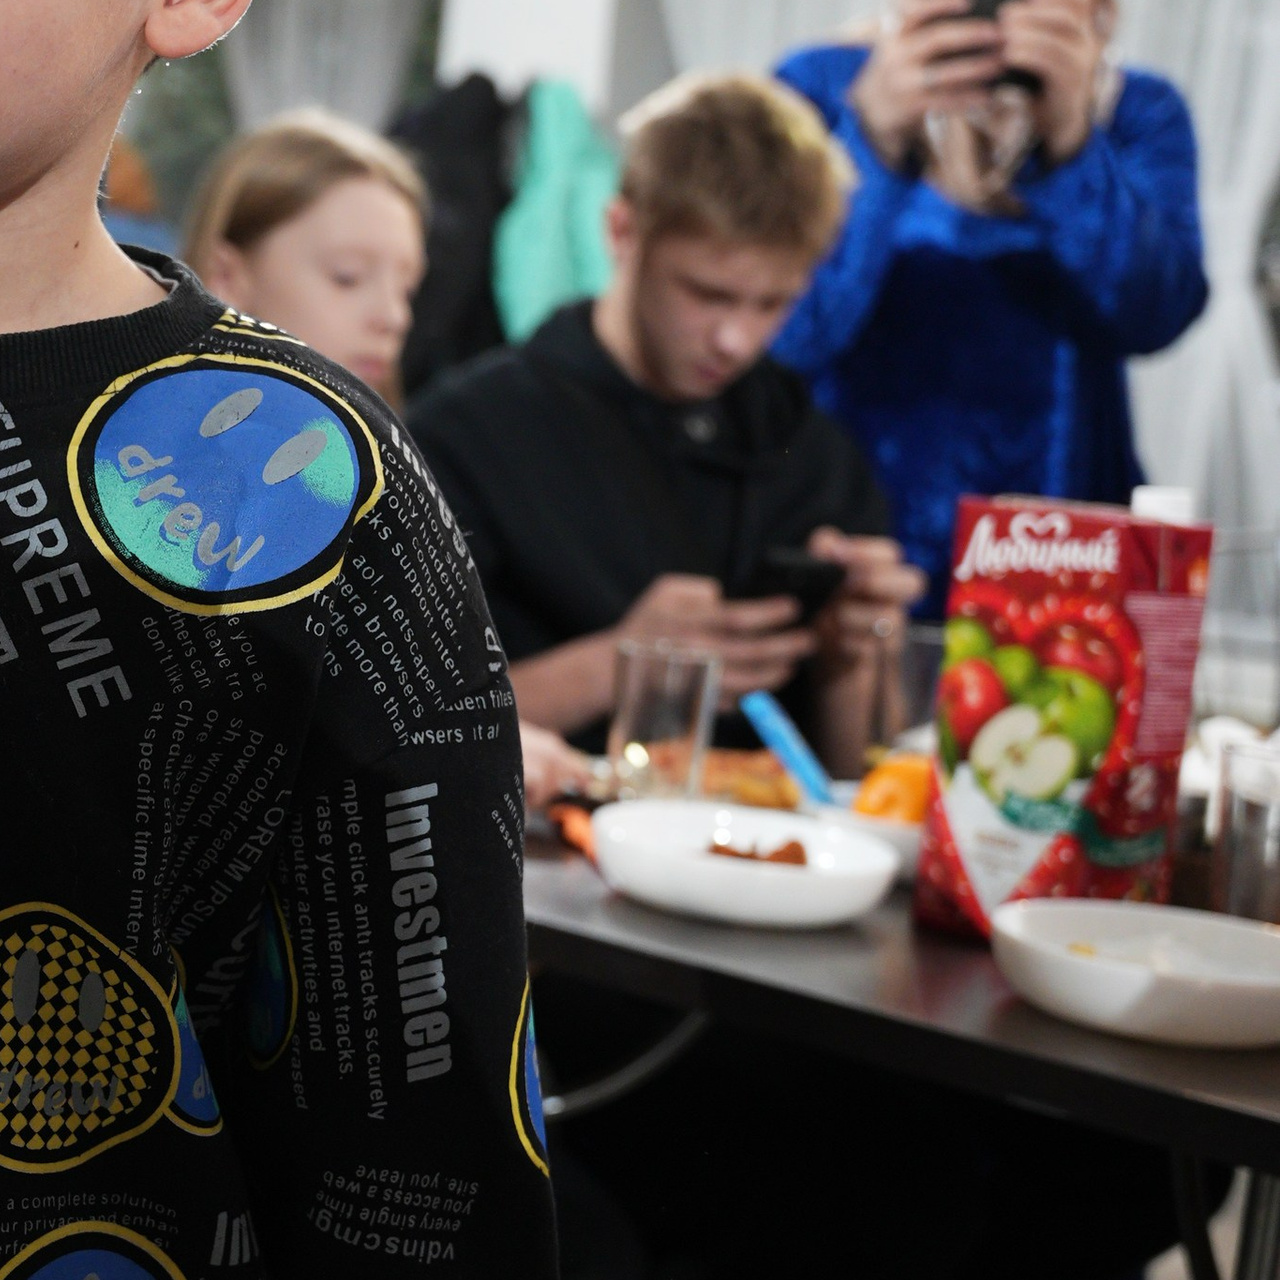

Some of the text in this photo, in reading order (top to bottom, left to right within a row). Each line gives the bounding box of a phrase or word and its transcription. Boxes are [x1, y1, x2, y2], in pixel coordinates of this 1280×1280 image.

[117, 443, 266, 573] drew
[379, 487, 413, 531] your
[352, 554, 385, 594] aol,
[953, 510, 1122, 581] Любимый
[392, 542, 434, 622] support
[165, 663, 185, 695] like
[203, 621, 231, 669] leave
[230, 629, 258, 667] you
[365, 614, 424, 718] browsers
[346, 639, 409, 747] more than
[132, 728, 157, 881] specific time
[233, 742, 288, 822] acrobat
[224, 789, 293, 883] LOREM
[171, 880, 234, 946] IPSUM
[315, 850, 349, 1009] your internet
[384, 782, 453, 1084] Investmen
[340, 778, 388, 1121] mple click tracks securely
[20, 1191, 97, 1215] complete
[100, 1191, 179, 1219] solution
[323, 1169, 441, 1210] access web
[355, 1164, 406, 1187] leave
[359, 1200, 417, 1230] single
